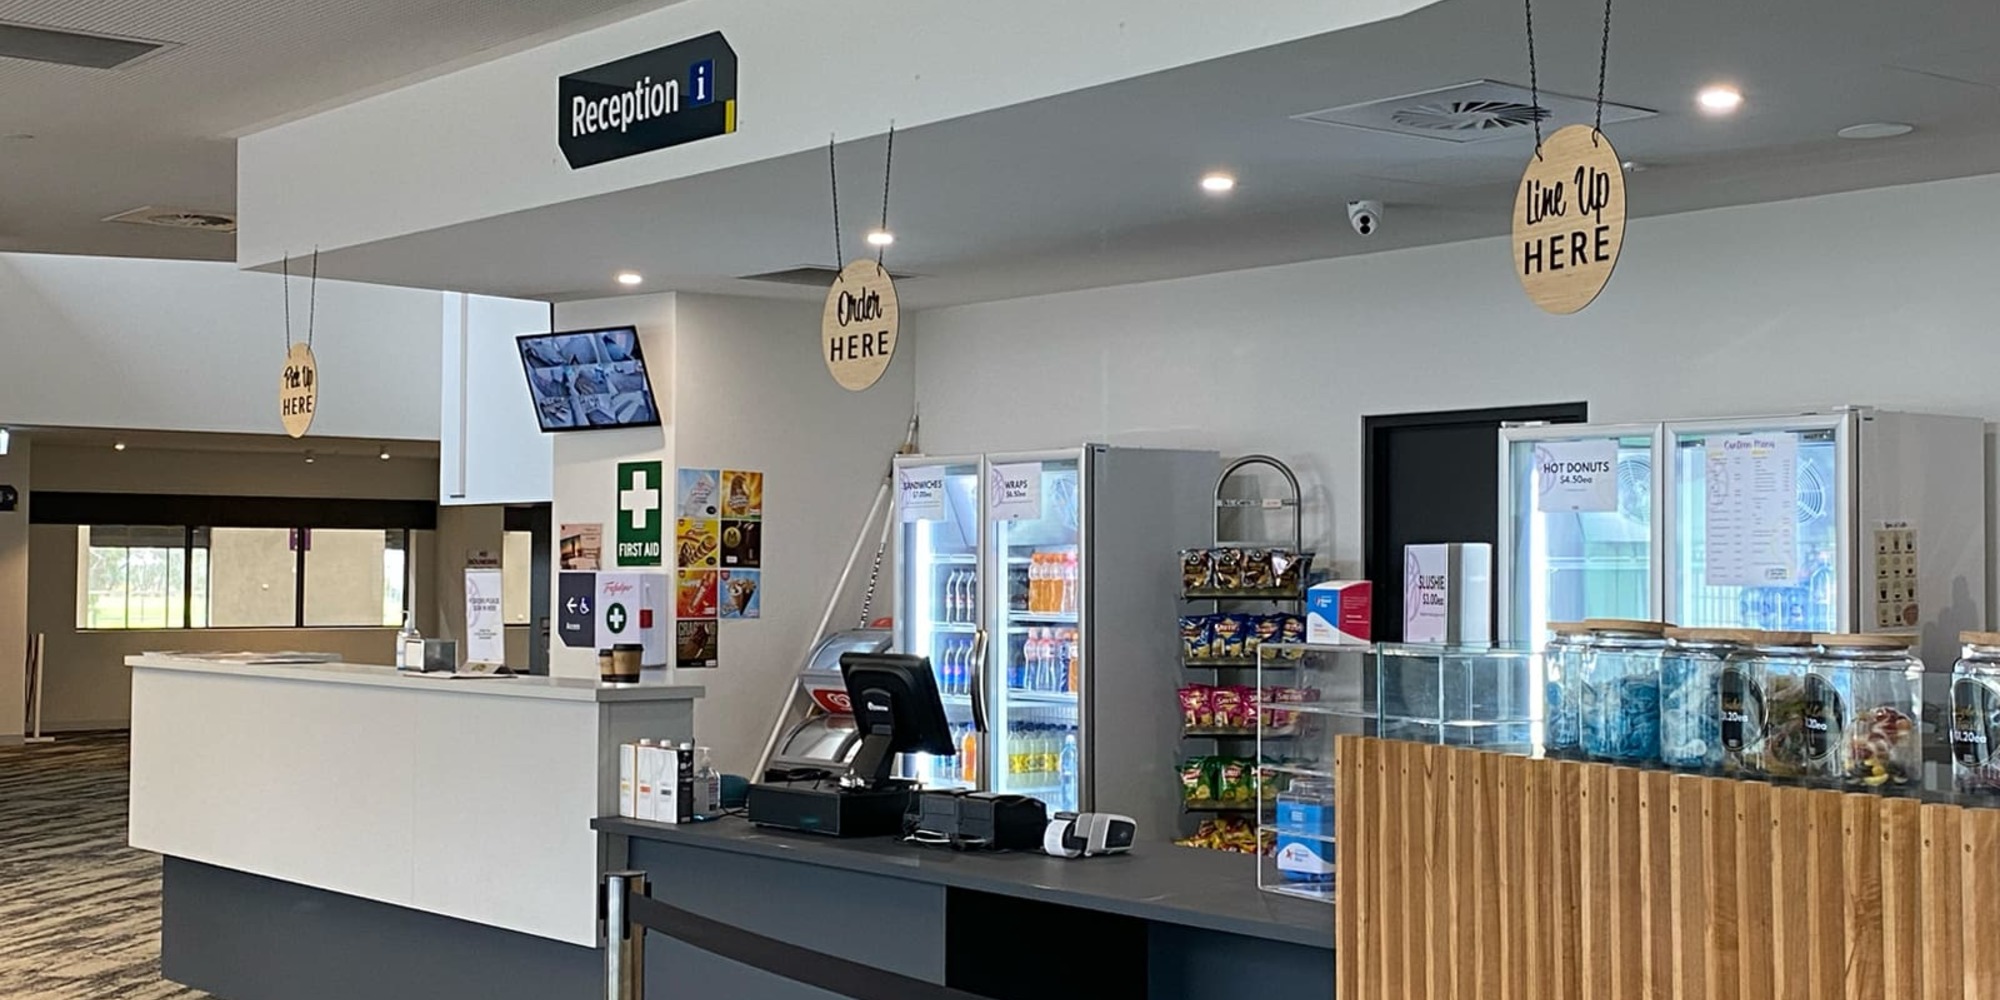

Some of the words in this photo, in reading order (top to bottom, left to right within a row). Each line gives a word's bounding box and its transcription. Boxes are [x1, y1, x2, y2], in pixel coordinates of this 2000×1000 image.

[572, 76, 679, 137] Reception
[1526, 179, 1567, 225] Line
[1573, 165, 1610, 224] Up
[1524, 225, 1610, 275] HERE
[838, 286, 883, 327] Order
[830, 330, 889, 362] HERE
[302, 365, 314, 393] Up
[283, 395, 313, 416] HERE
[1543, 462, 1565, 474] HOT
[1566, 461, 1610, 473] DONUTS
[903, 480, 942, 491] SANDWICHES
[1005, 480, 1028, 489] WRAPS
[1560, 475, 1593, 484] $4.50ea
[619, 542, 643, 557] FIRST
[644, 542, 660, 557] AID
[1418, 575, 1445, 590] SLUSHIE
